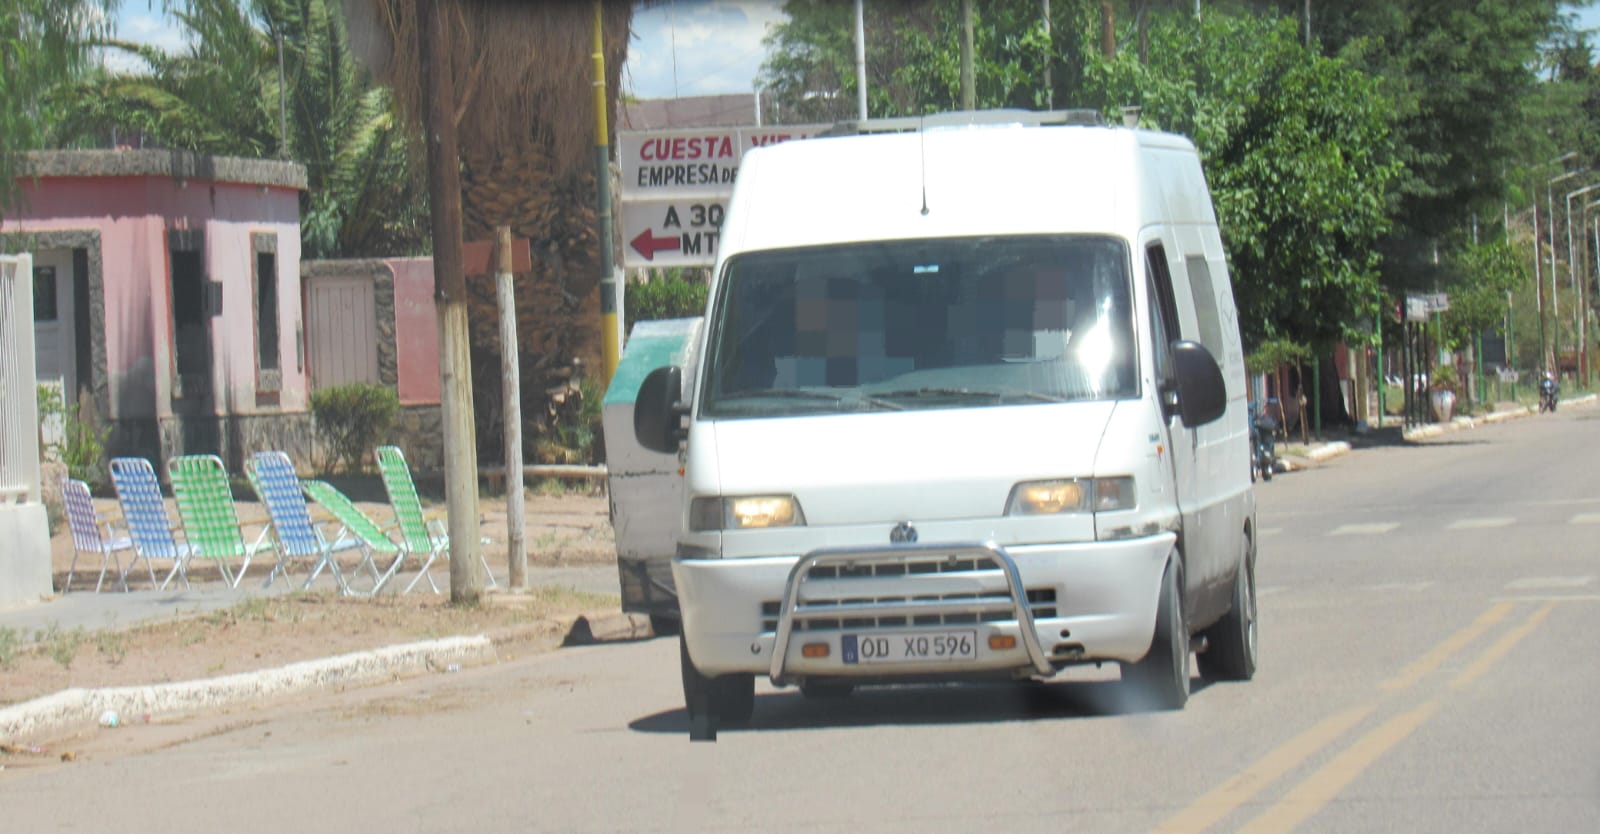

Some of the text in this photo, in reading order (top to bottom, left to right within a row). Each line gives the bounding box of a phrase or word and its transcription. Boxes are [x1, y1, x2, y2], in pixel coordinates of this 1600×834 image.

[640, 136, 733, 161] CUESTA
[638, 163, 719, 188] EMPRESA
[663, 204, 681, 229] A
[861, 637, 889, 658] OD
[933, 634, 971, 656] 596
